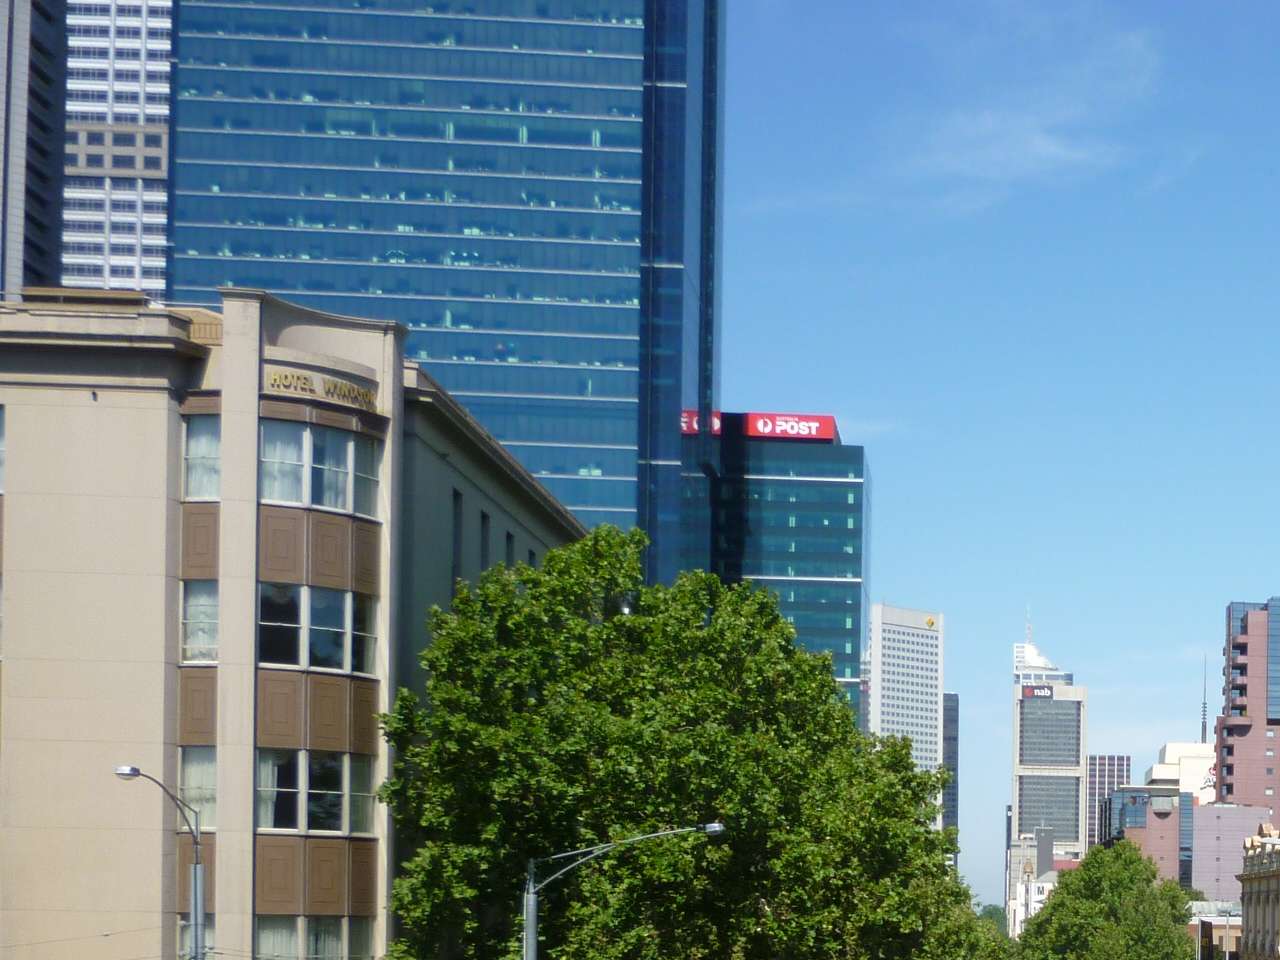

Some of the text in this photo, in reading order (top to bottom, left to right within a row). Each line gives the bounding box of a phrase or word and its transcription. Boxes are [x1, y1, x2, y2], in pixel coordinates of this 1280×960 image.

[270, 371, 317, 395] HOTEL
[775, 421, 820, 435] POST
[1034, 687, 1051, 696] nab
